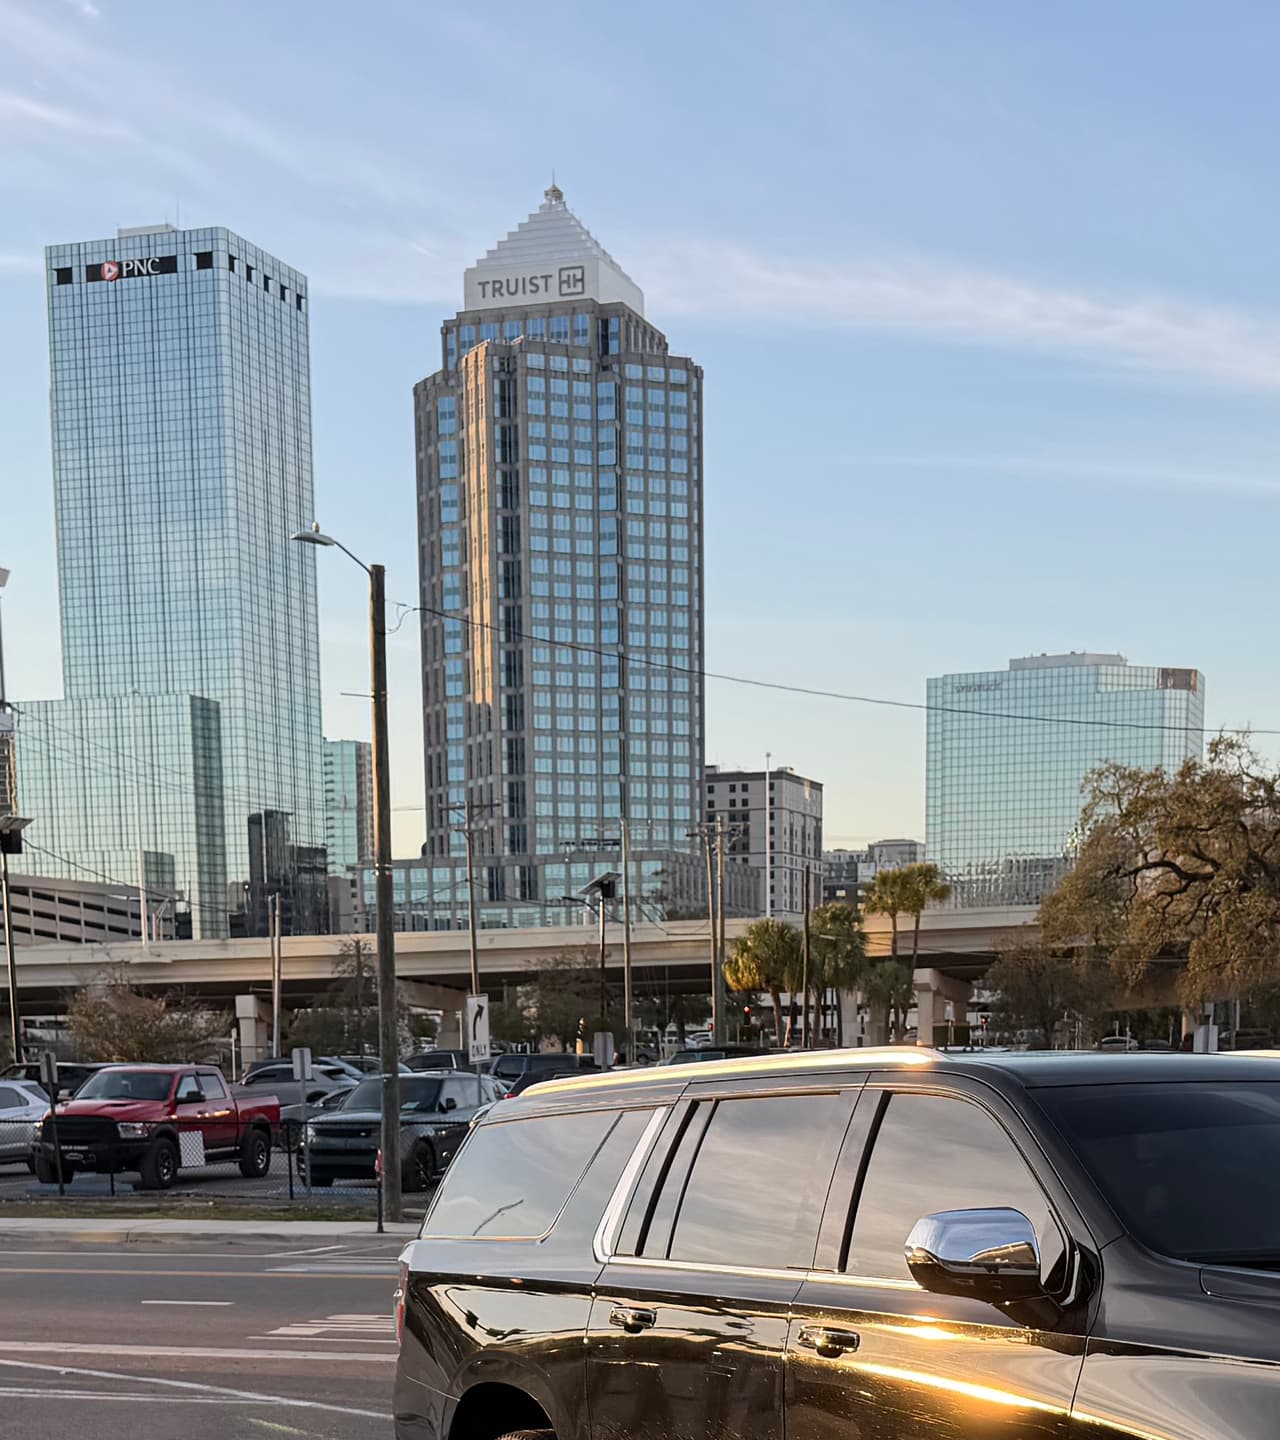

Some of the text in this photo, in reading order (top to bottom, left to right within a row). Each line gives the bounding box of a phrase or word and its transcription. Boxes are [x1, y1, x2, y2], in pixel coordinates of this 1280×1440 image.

[122, 257, 161, 277] PNC
[477, 274, 553, 299] TRUIST
[471, 1044, 487, 1058] ONLY
